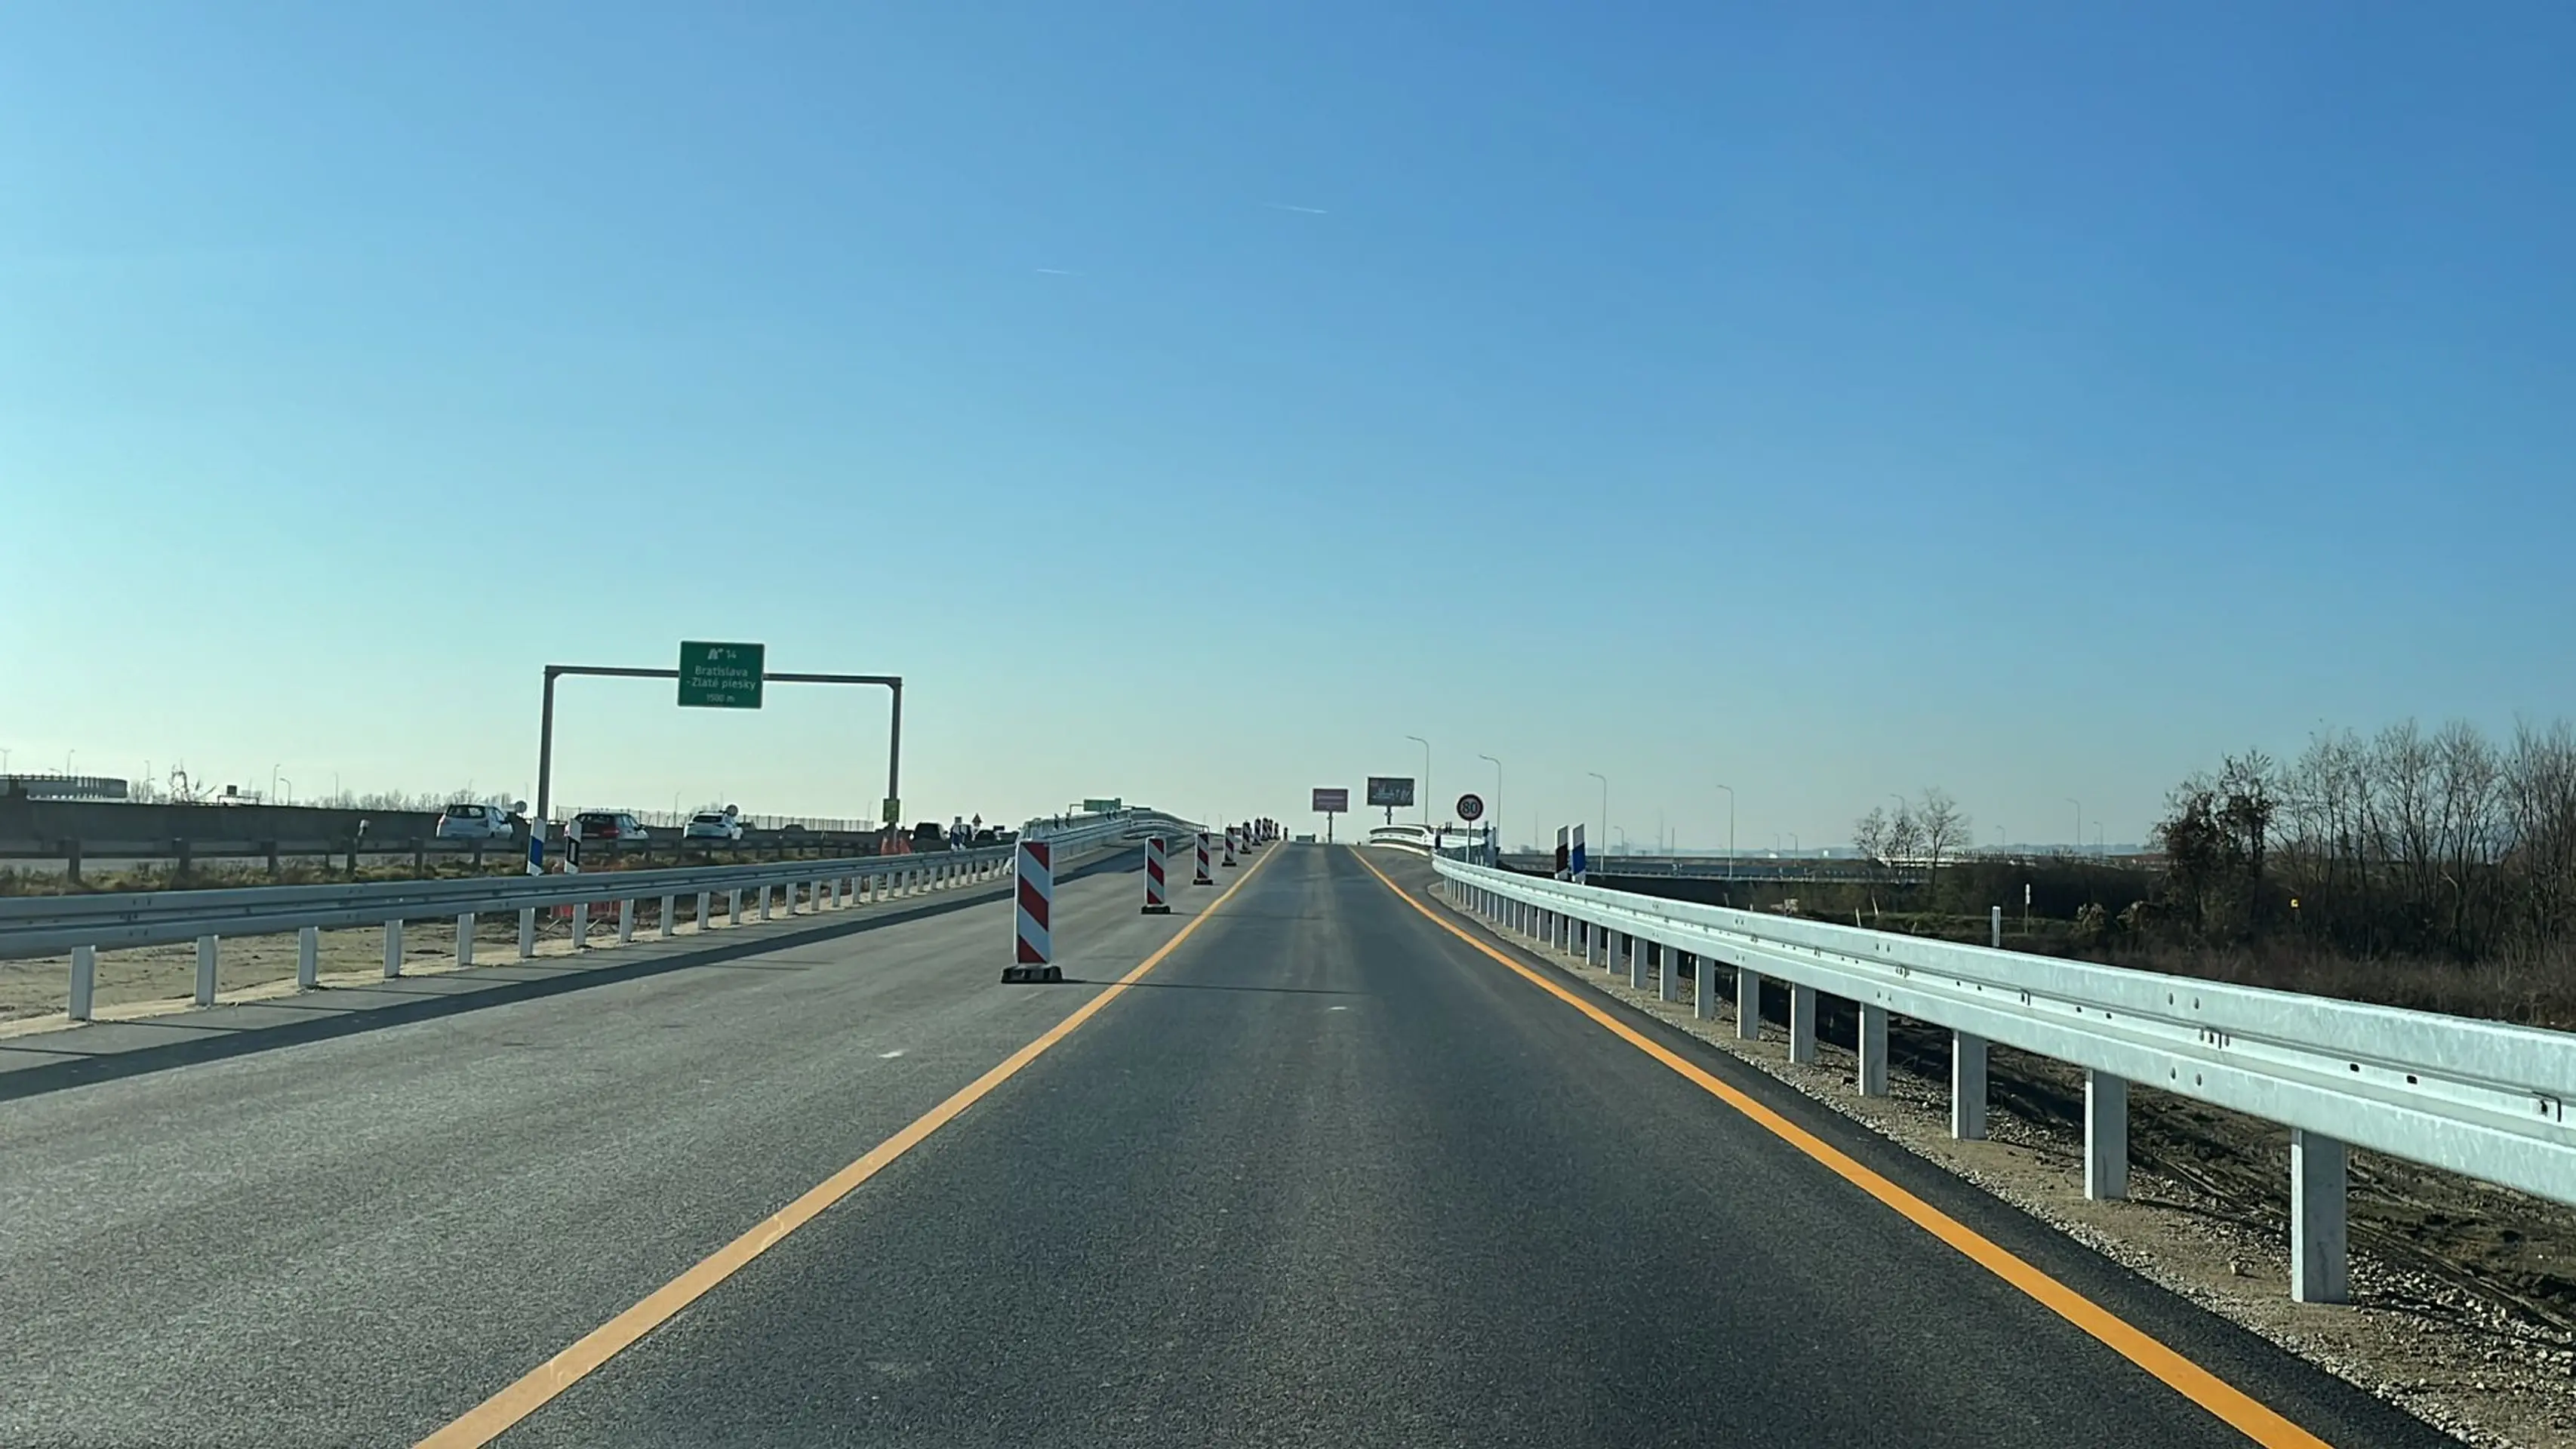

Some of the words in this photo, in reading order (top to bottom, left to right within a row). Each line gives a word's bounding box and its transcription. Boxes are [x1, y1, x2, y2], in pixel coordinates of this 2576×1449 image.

[726, 651, 737, 659] 14
[695, 665, 749, 677] Bratislava
[722, 678, 756, 691] piesky
[1463, 801, 1478, 814] 80
